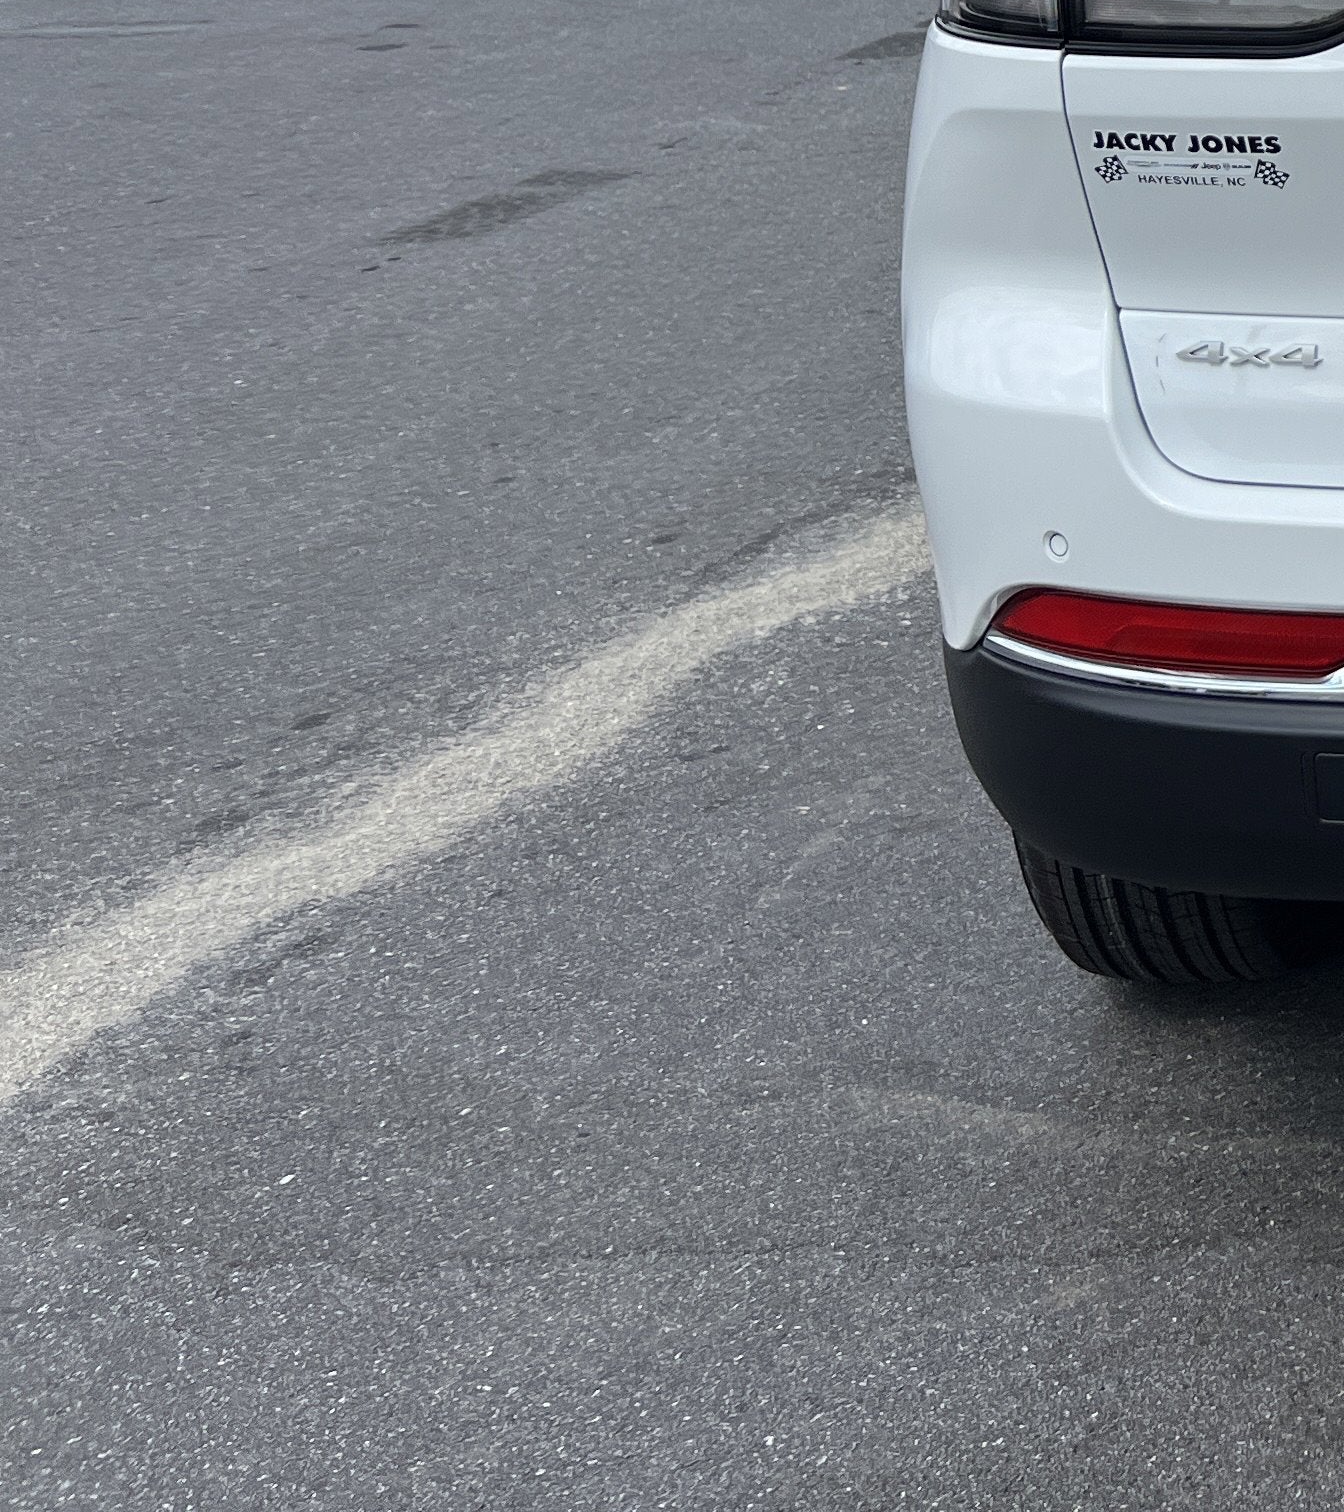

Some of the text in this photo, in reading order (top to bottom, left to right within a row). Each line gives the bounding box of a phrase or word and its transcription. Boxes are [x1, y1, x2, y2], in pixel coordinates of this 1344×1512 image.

[1093, 131, 1282, 154] JACKY JONES
[1137, 174, 1247, 187] HAYESVILLE, NC
[1176, 340, 1325, 369] 4x4
